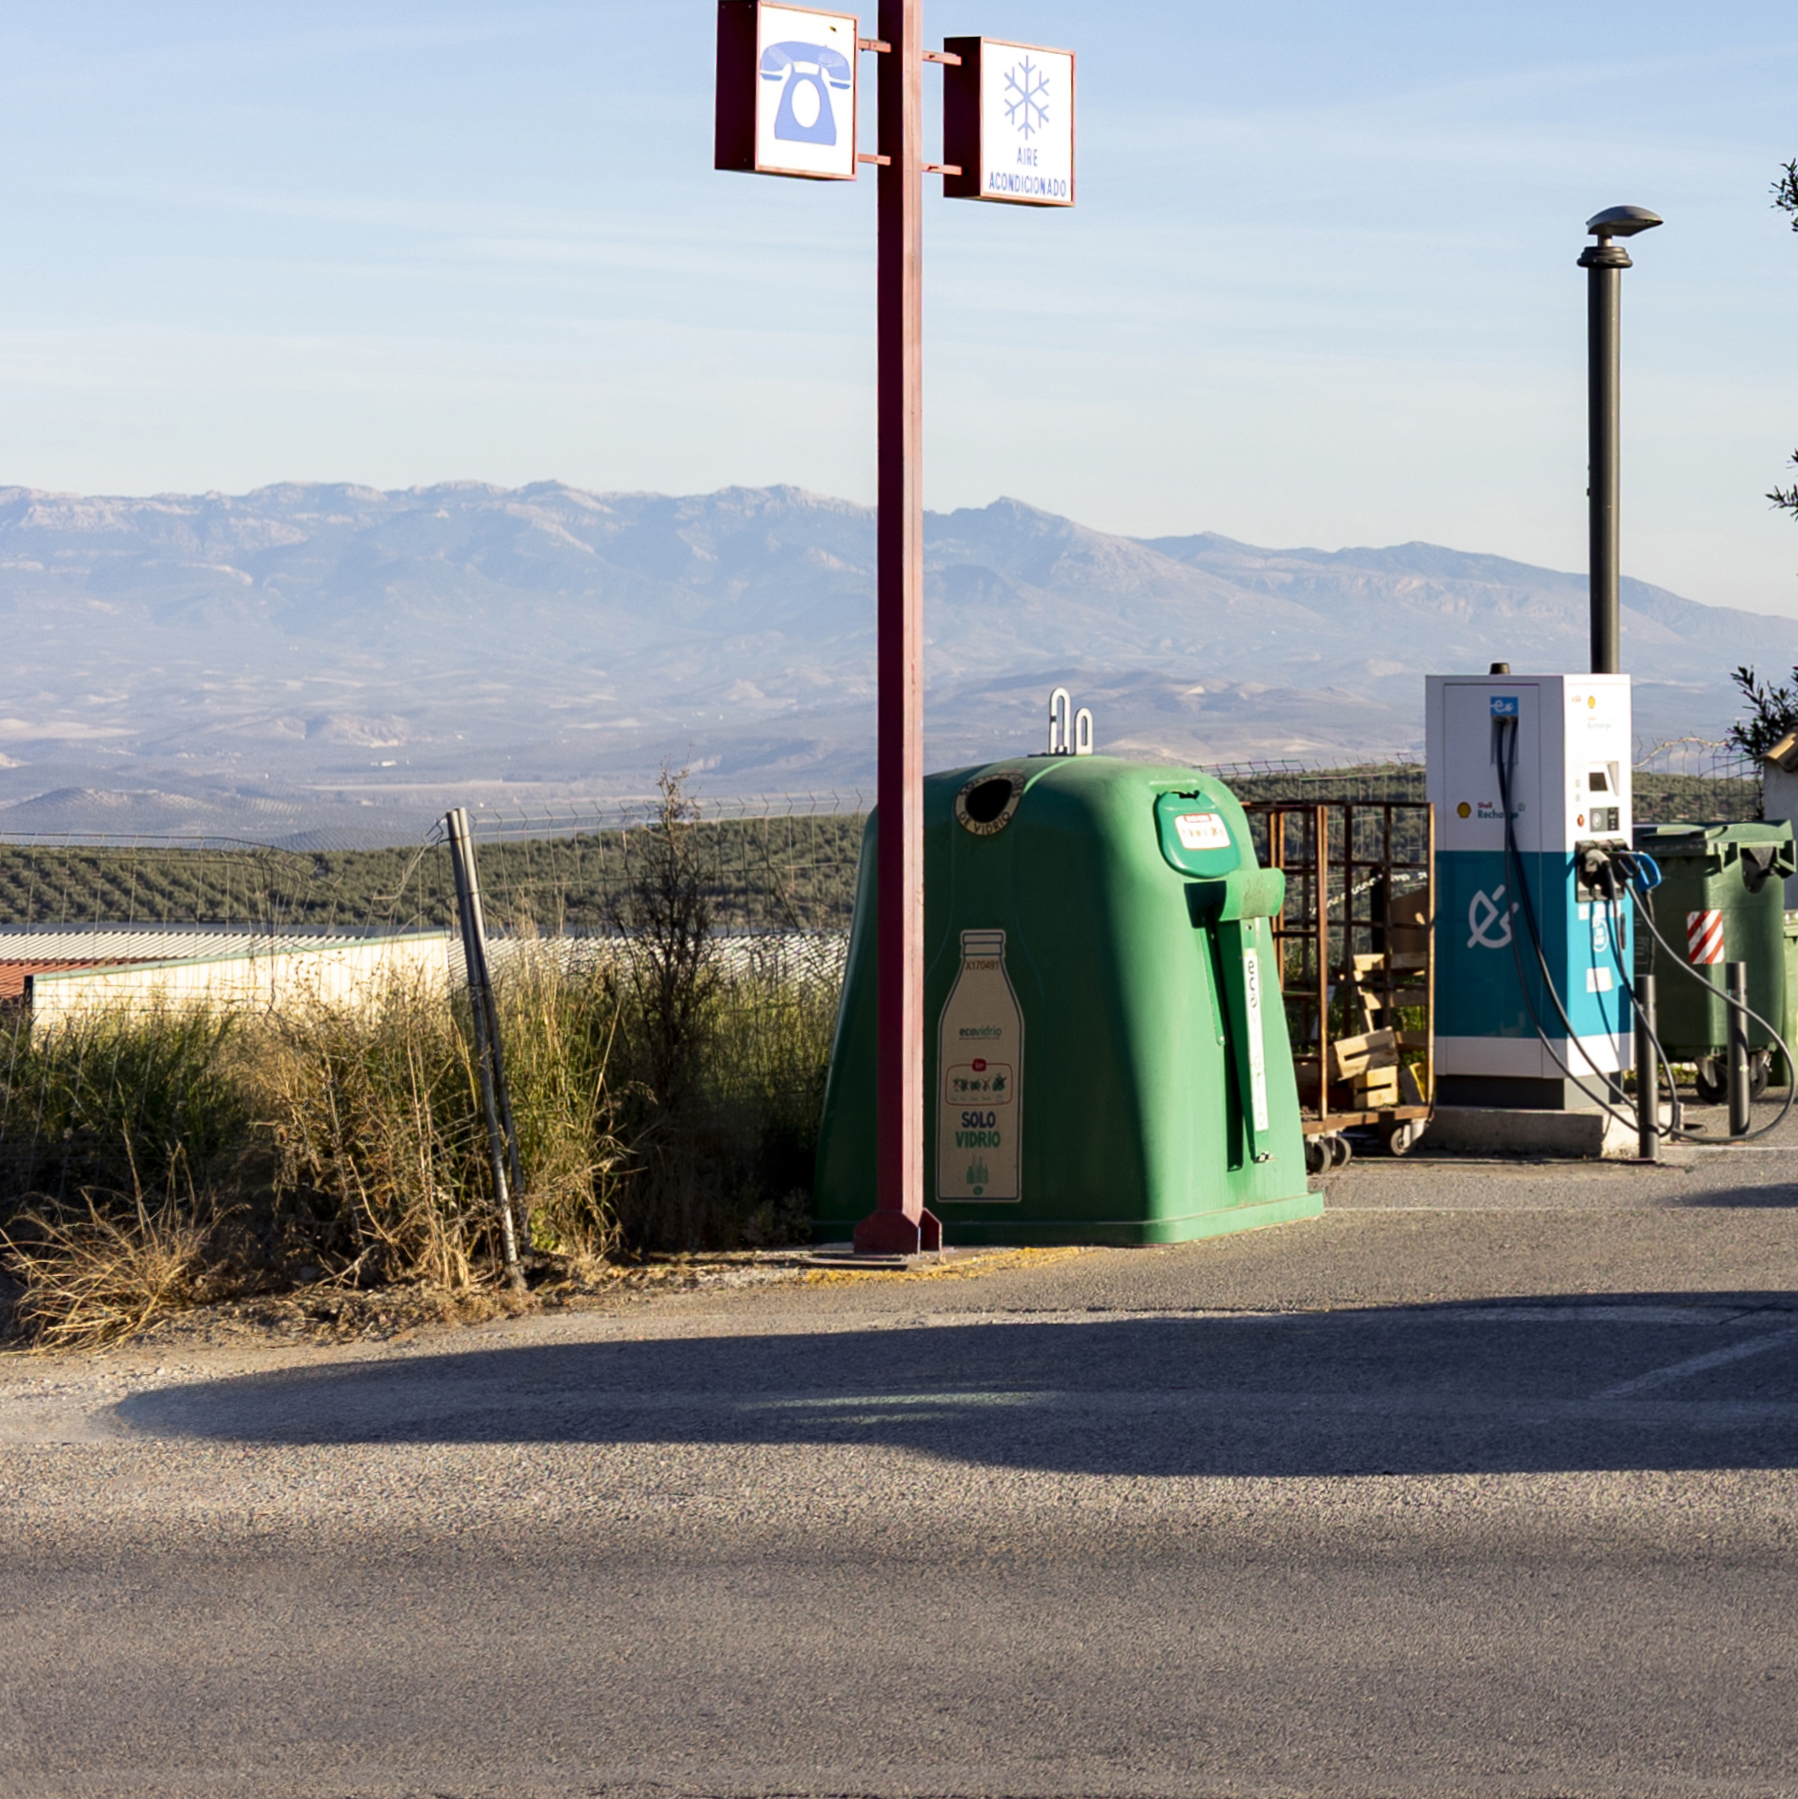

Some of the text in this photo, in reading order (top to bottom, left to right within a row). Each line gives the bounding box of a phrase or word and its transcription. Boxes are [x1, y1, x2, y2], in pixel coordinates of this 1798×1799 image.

[1017, 147, 1038, 167] AIRE
[989, 171, 1067, 197] ACONDICIONADO
[973, 811, 1010, 835] VIDRIO
[1477, 809, 1519, 821] Rechage
[965, 961, 1000, 971] X170491
[959, 1024, 1002, 1036] ecovidrio
[961, 1110, 996, 1128] SOLO
[955, 1130, 1001, 1149] VIDRIO
